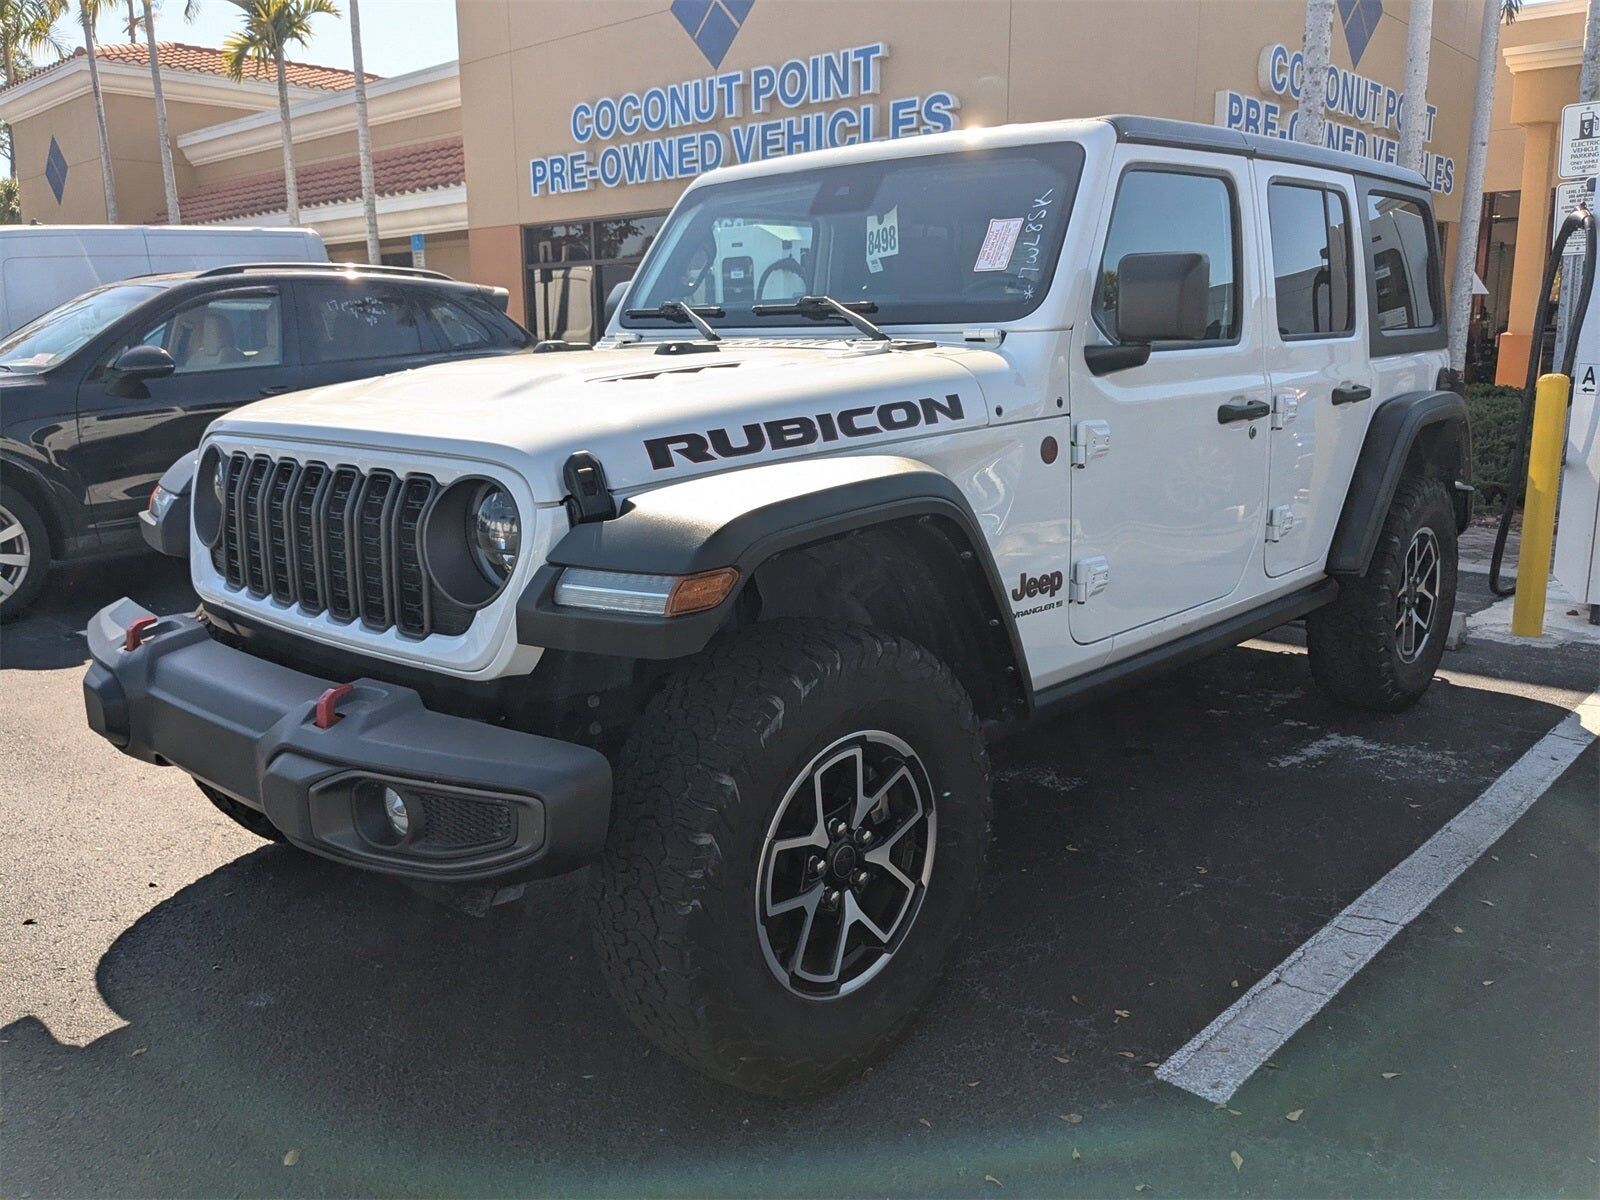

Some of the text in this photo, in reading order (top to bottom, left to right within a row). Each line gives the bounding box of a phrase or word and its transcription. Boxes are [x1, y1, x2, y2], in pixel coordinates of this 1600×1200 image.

[571, 42, 885, 143] COCONUT POINT
[1268, 43, 1384, 123] COONUT
[530, 91, 956, 196] PRE-OWNED VEHICLES
[1226, 89, 1454, 195] PRE-NED VELES
[1570, 151, 1599, 159] PARKING
[1571, 140, 1600, 148] ELECTRIC
[1572, 145, 1598, 153] VEHICLE
[868, 225, 896, 255] 8498
[1582, 366, 1595, 385] A
[643, 394, 964, 470] RUBICON
[1011, 571, 1063, 601] Jeep
